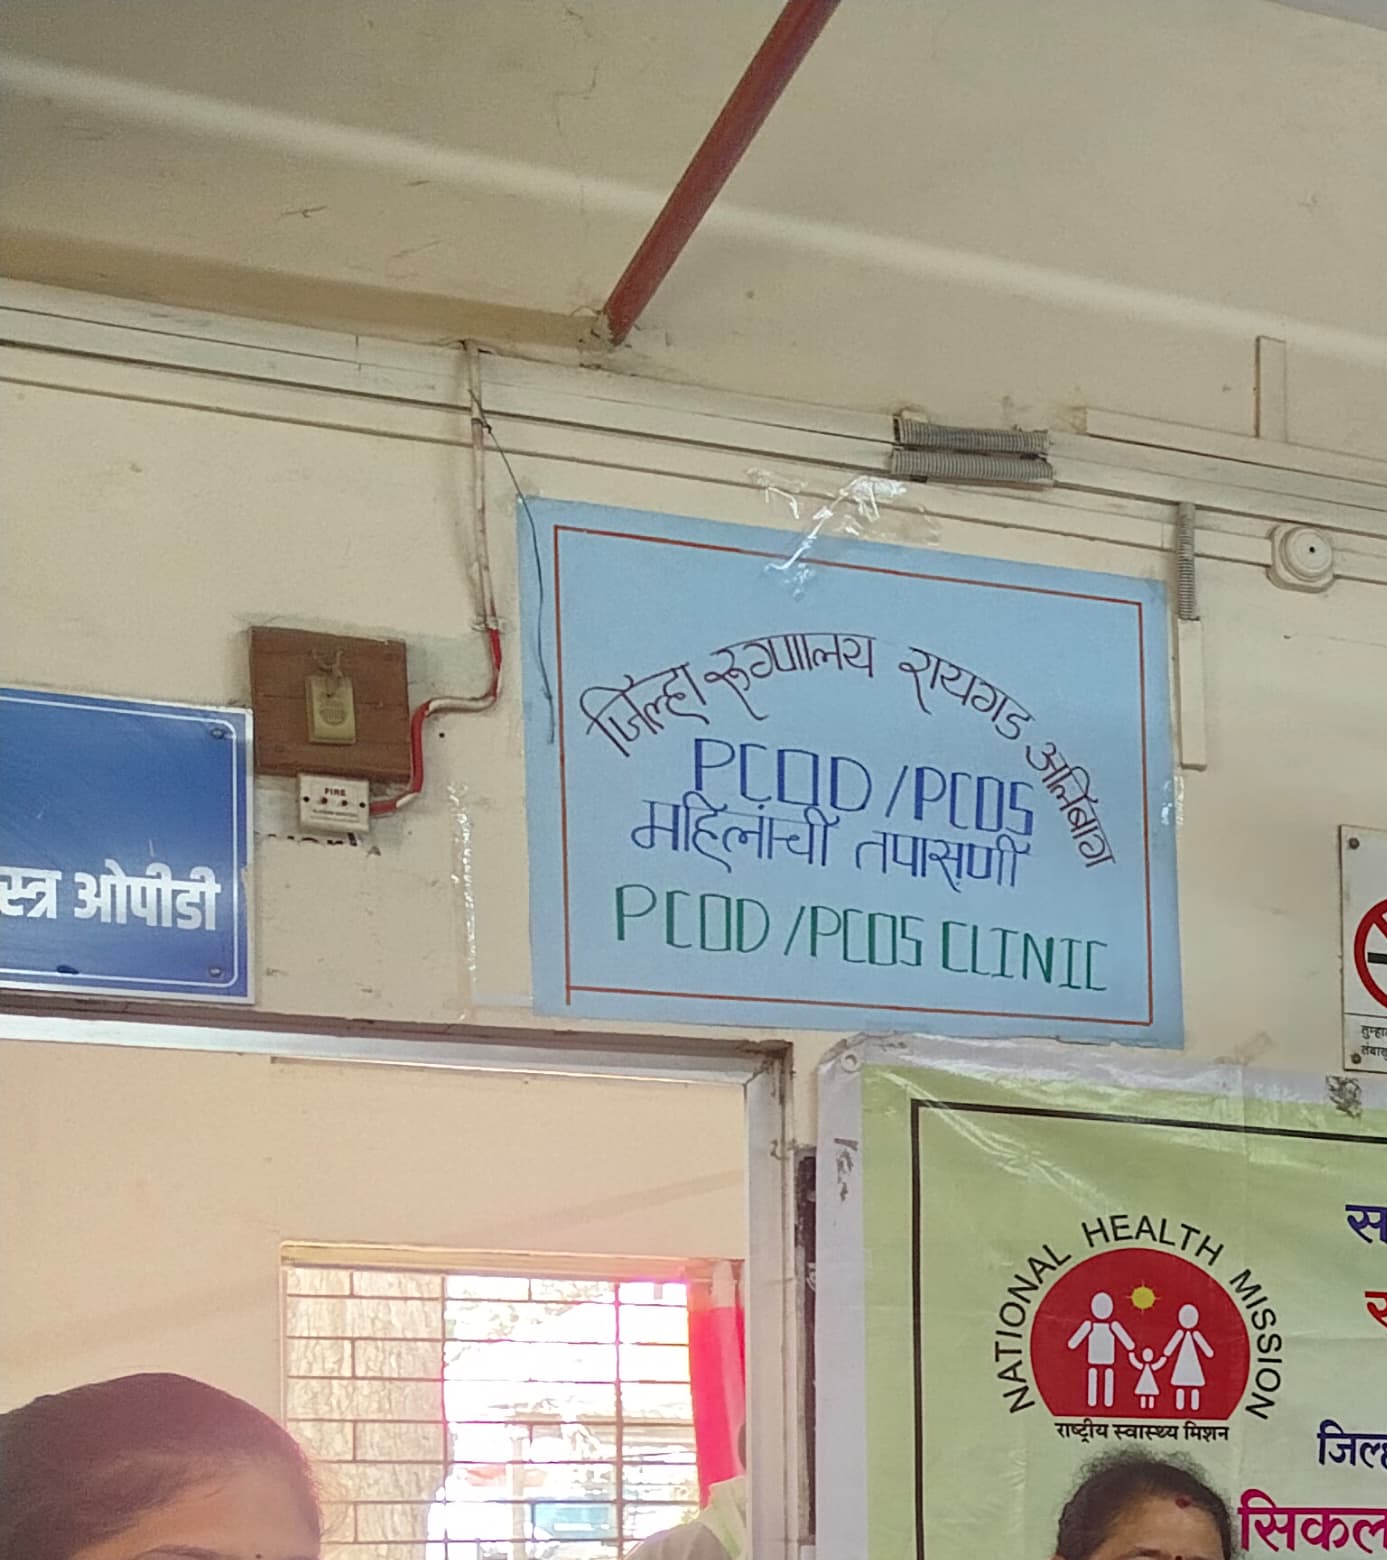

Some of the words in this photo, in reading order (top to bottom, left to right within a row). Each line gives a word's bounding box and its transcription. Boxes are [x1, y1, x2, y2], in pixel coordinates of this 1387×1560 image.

[324, 787, 346, 797] FIRE
[579, 663, 708, 756] जिल्हा
[899, 646, 1037, 740] रायगड
[1026, 742, 1114, 868] अलिबाग
[694, 738, 871, 812] PCOD
[74, 858, 221, 930] ओपीडी
[616, 885, 769, 953] PCOD
[942, 920, 1107, 991] CLINIC
[995, 1244, 1072, 1414] NATIONAL
[1081, 1214, 1224, 1266] HEALTH
[1228, 1268, 1283, 1420] MISSION
[1054, 1418, 1108, 1443] राष्ट्रीय
[1183, 1420, 1229, 1442] मिशन
